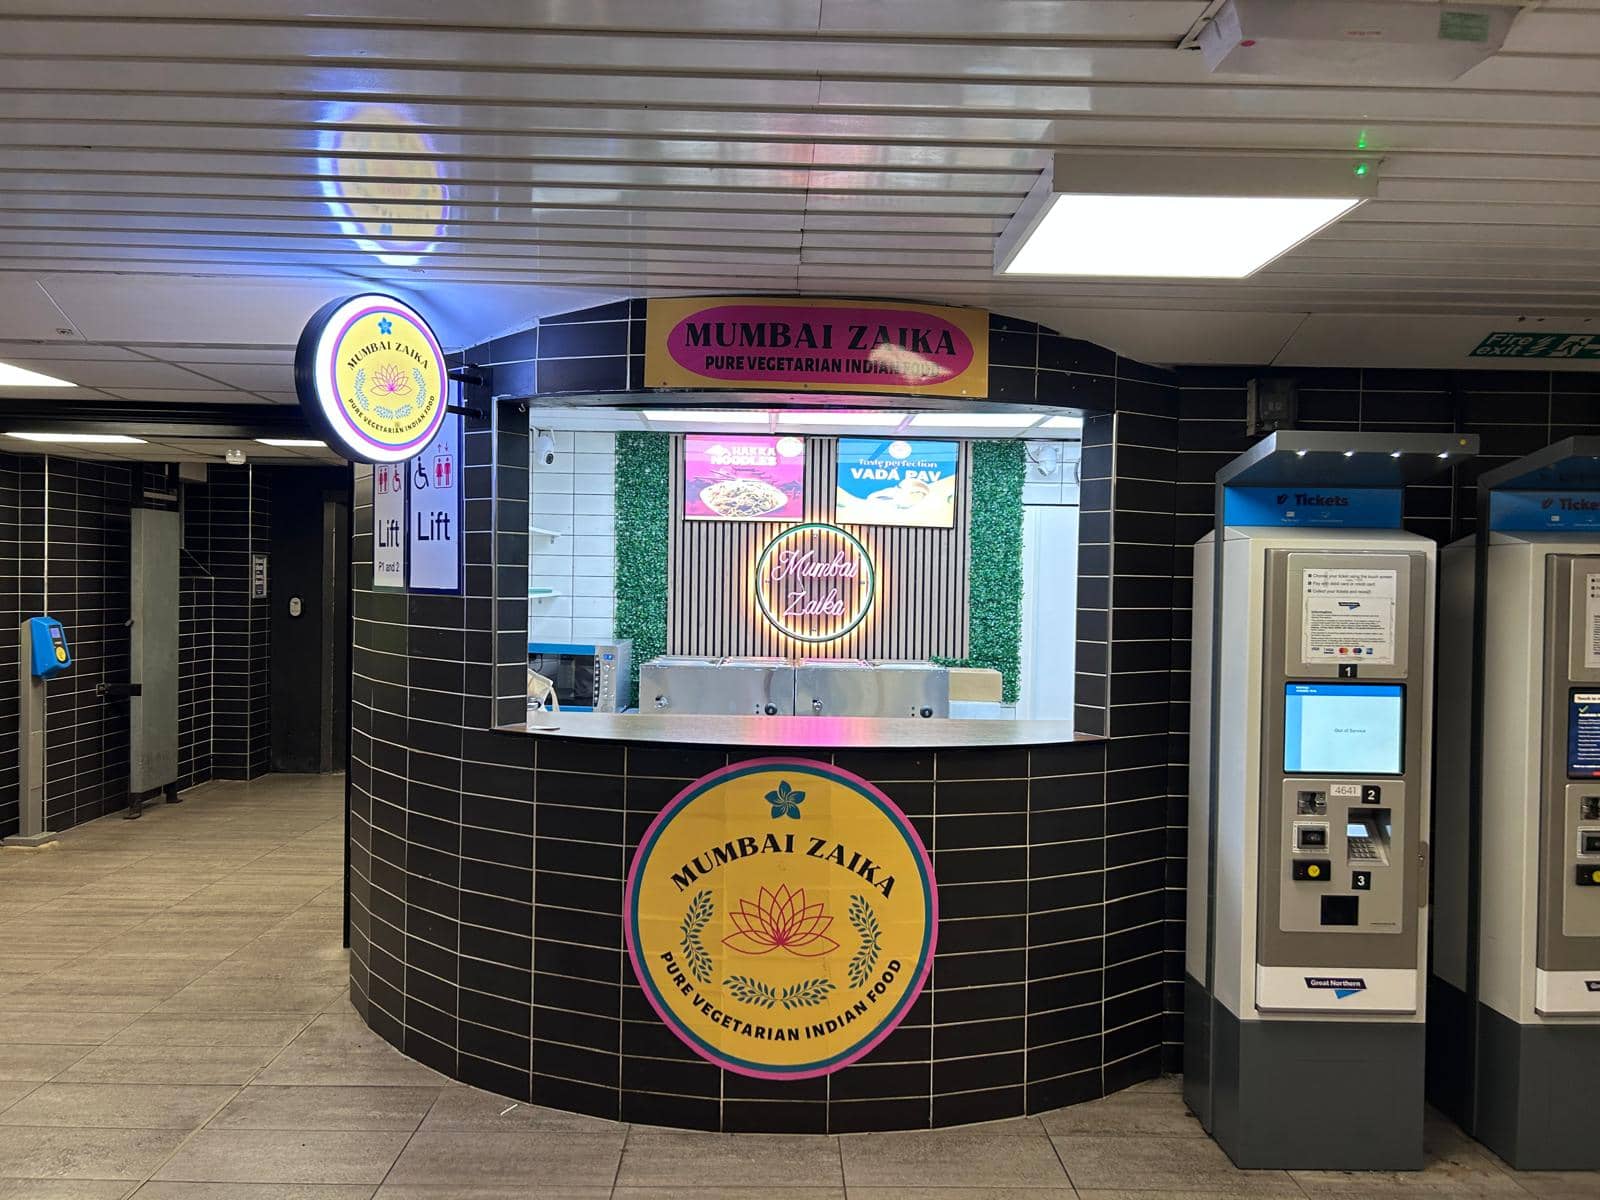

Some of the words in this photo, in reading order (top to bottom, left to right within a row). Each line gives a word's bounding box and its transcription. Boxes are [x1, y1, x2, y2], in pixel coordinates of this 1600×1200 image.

[684, 322, 832, 349] MUMBAI
[847, 325, 956, 355] ZAIKA
[1486, 333, 1533, 345] Fire
[347, 341, 391, 371] MUMBAI
[395, 342, 428, 369] ZAIKA
[1476, 345, 1521, 355] exit
[705, 355, 745, 370] PURE
[747, 356, 841, 372] VEGETARIAN
[845, 358, 899, 374] INDIAN
[348, 398, 363, 418] PURE
[363, 417, 404, 434] VEGETARIAN
[405, 414, 426, 432] INDIAN
[424, 395, 435, 415] FOOD
[711, 455, 777, 466] NOODLES
[905, 470, 941, 482] PAV
[1294, 494, 1348, 506] Tickets
[378, 519, 400, 547] Lift
[418, 511, 450, 541] Lift
[378, 561, 385, 572] P1
[385, 562, 395, 572] and
[395, 562, 400, 572] 2
[771, 550, 858, 584] Mumbai
[783, 588, 846, 616] Zaika
[1345, 667, 1351, 677] 1
[1335, 786, 1357, 794] 4641
[1367, 790, 1375, 800] 2
[670, 833, 794, 892] MUMBAI
[806, 837, 896, 899] ZAIKA
[1357, 875, 1365, 886] 3
[1310, 979, 1330, 987] Great
[1330, 979, 1361, 988] Northern
[660, 951, 694, 997] PURE
[692, 994, 800, 1041] VEGETARIAN
[805, 1001, 869, 1040] INDIAN
[866, 958, 902, 1004] FOOD
